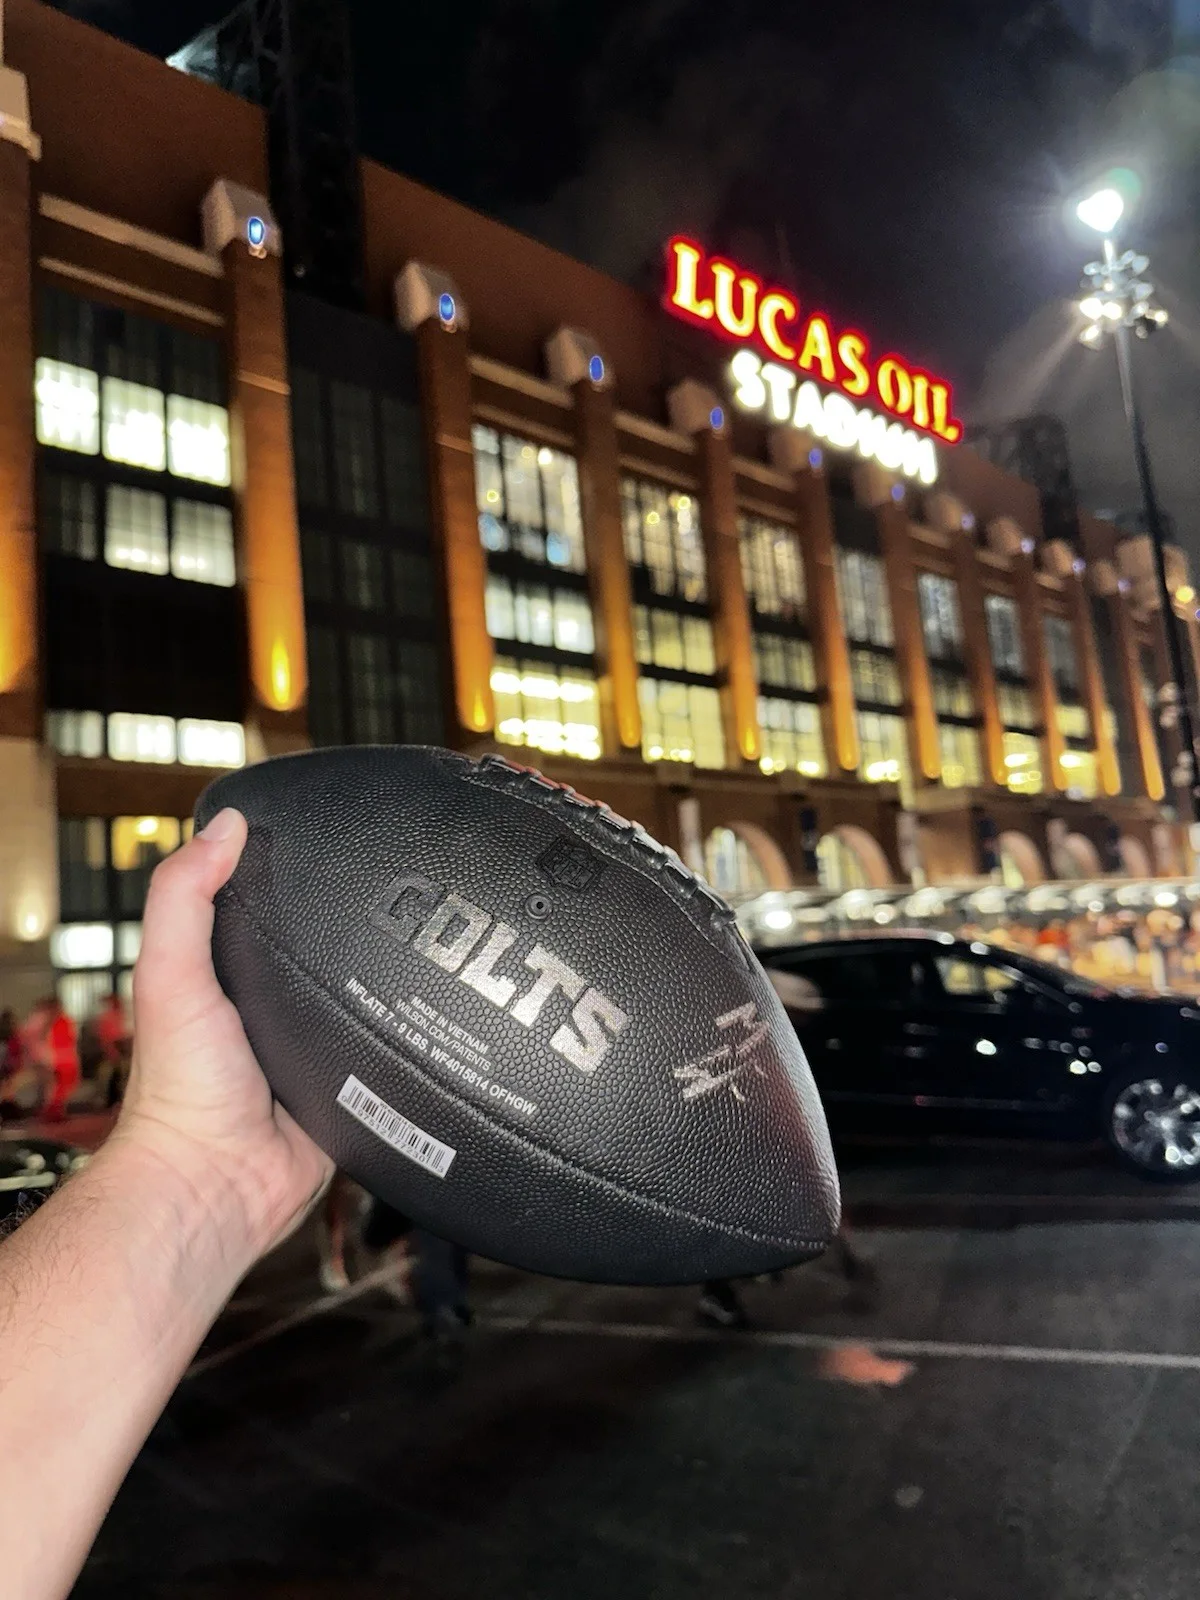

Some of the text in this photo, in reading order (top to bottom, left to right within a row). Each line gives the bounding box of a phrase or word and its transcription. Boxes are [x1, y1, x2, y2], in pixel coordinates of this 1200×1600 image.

[671, 240, 961, 443] LUCAS OIL
[730, 349, 938, 485] STADIUM
[366, 866, 628, 1073] COLTS
[396, 998, 492, 1072] WILSON.COM/PATENTS
[410, 996, 489, 1055] MADE IN VIETNAM
[346, 977, 388, 1018] INFLATE
[385, 1011, 395, 1022] 7
[397, 1022, 407, 1034] 9
[405, 1028, 429, 1054] LBS.
[430, 1045, 490, 1091] WF4015814
[489, 1084, 537, 1115] OFHGW
